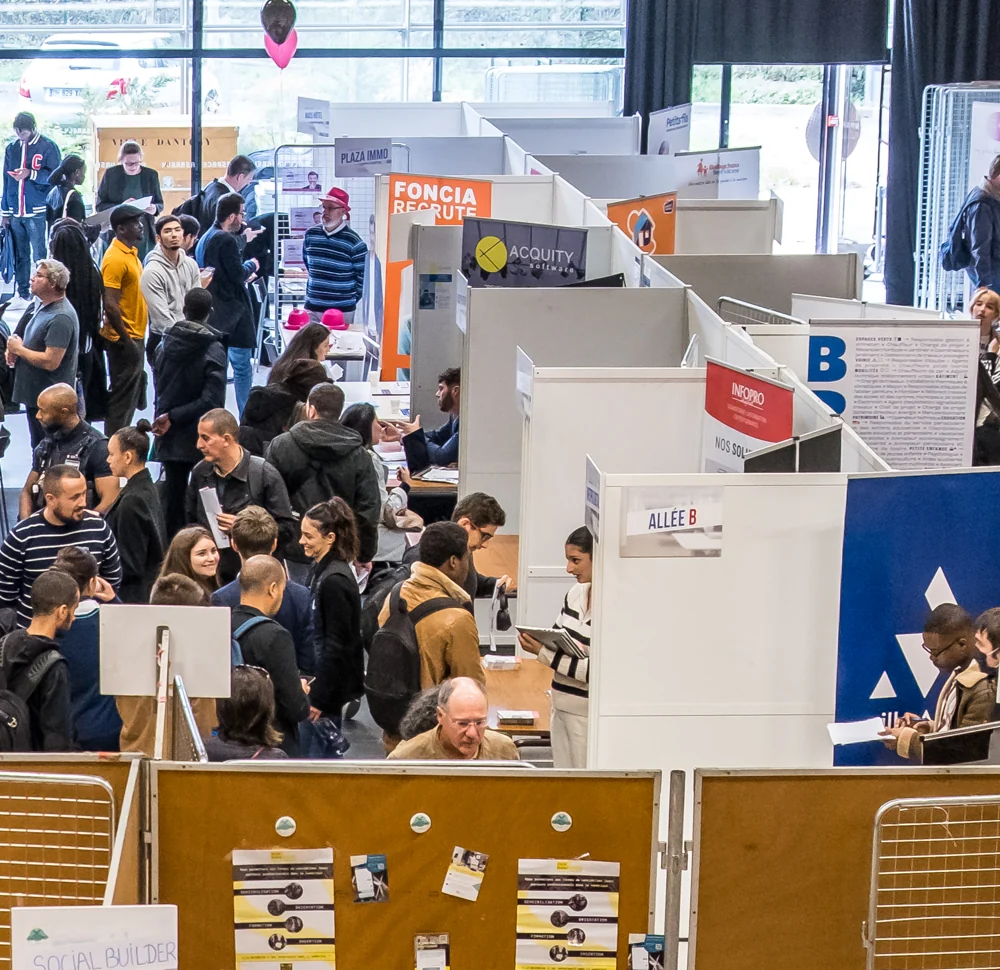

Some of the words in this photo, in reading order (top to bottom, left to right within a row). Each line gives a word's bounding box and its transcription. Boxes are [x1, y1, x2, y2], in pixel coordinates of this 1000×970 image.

[31, 153, 43, 170] C
[341, 151, 365, 164] PLAZA
[367, 149, 389, 161] IMMO
[394, 181, 477, 205] FONCIA
[509, 245, 575, 264] ACQUITY
[529, 262, 575, 274] software
[807, 335, 848, 382] B
[732, 382, 765, 406] INFOPRO
[714, 435, 731, 453] NOS
[648, 507, 686, 530] ALLÉE
[688, 508, 697, 526] B
